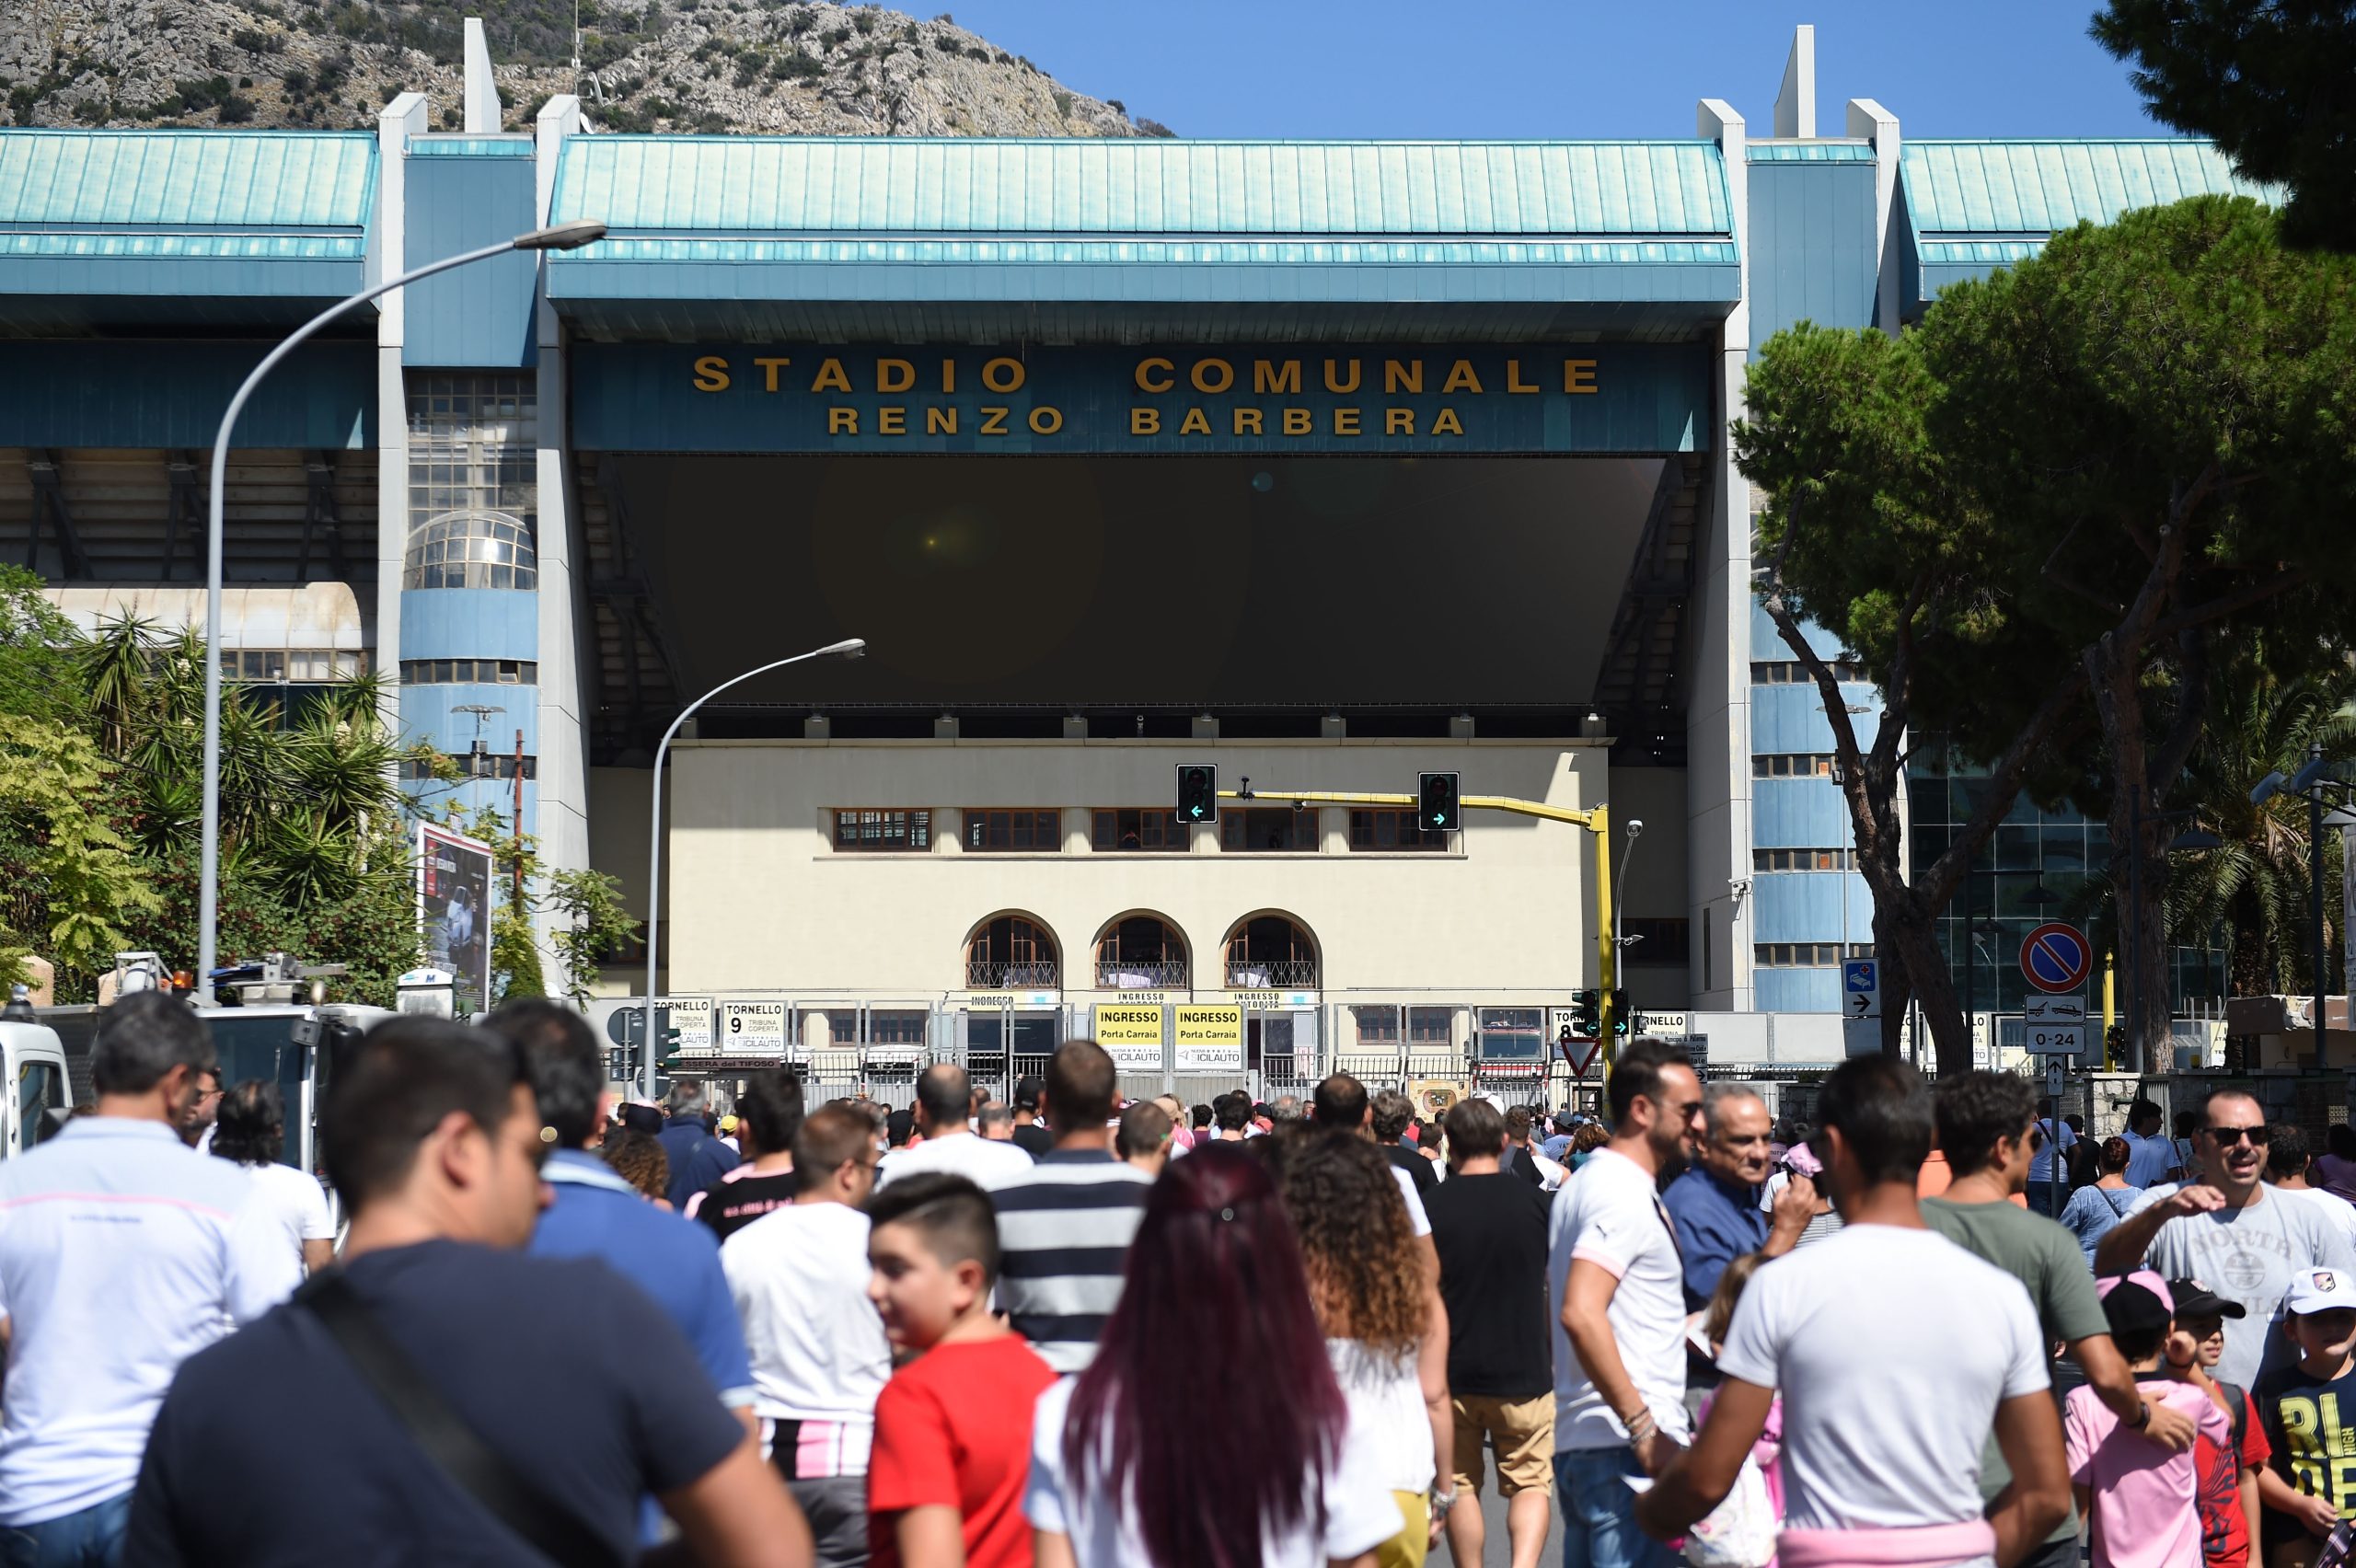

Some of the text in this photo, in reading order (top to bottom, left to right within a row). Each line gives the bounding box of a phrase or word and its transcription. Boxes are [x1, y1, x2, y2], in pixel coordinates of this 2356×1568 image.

[693, 356, 1599, 394] STADIO COMUNALE
[829, 406, 1464, 435] RENZO BARBERA
[727, 1005, 781, 1014] TORNELLO
[1101, 1012, 1159, 1022] INGRESSO
[1180, 1013, 1238, 1022] INGRESSO
[1646, 1016, 1683, 1026] RNELLO
[731, 1017, 742, 1033] 9
[1101, 1030, 1157, 1039] Porta Carraia
[1180, 1030, 1237, 1039] Porta Carraia
[1561, 1024, 1571, 1038] 8
[2036, 1033, 2074, 1046] 0-24
[2192, 1229, 2292, 1260] NORTH
